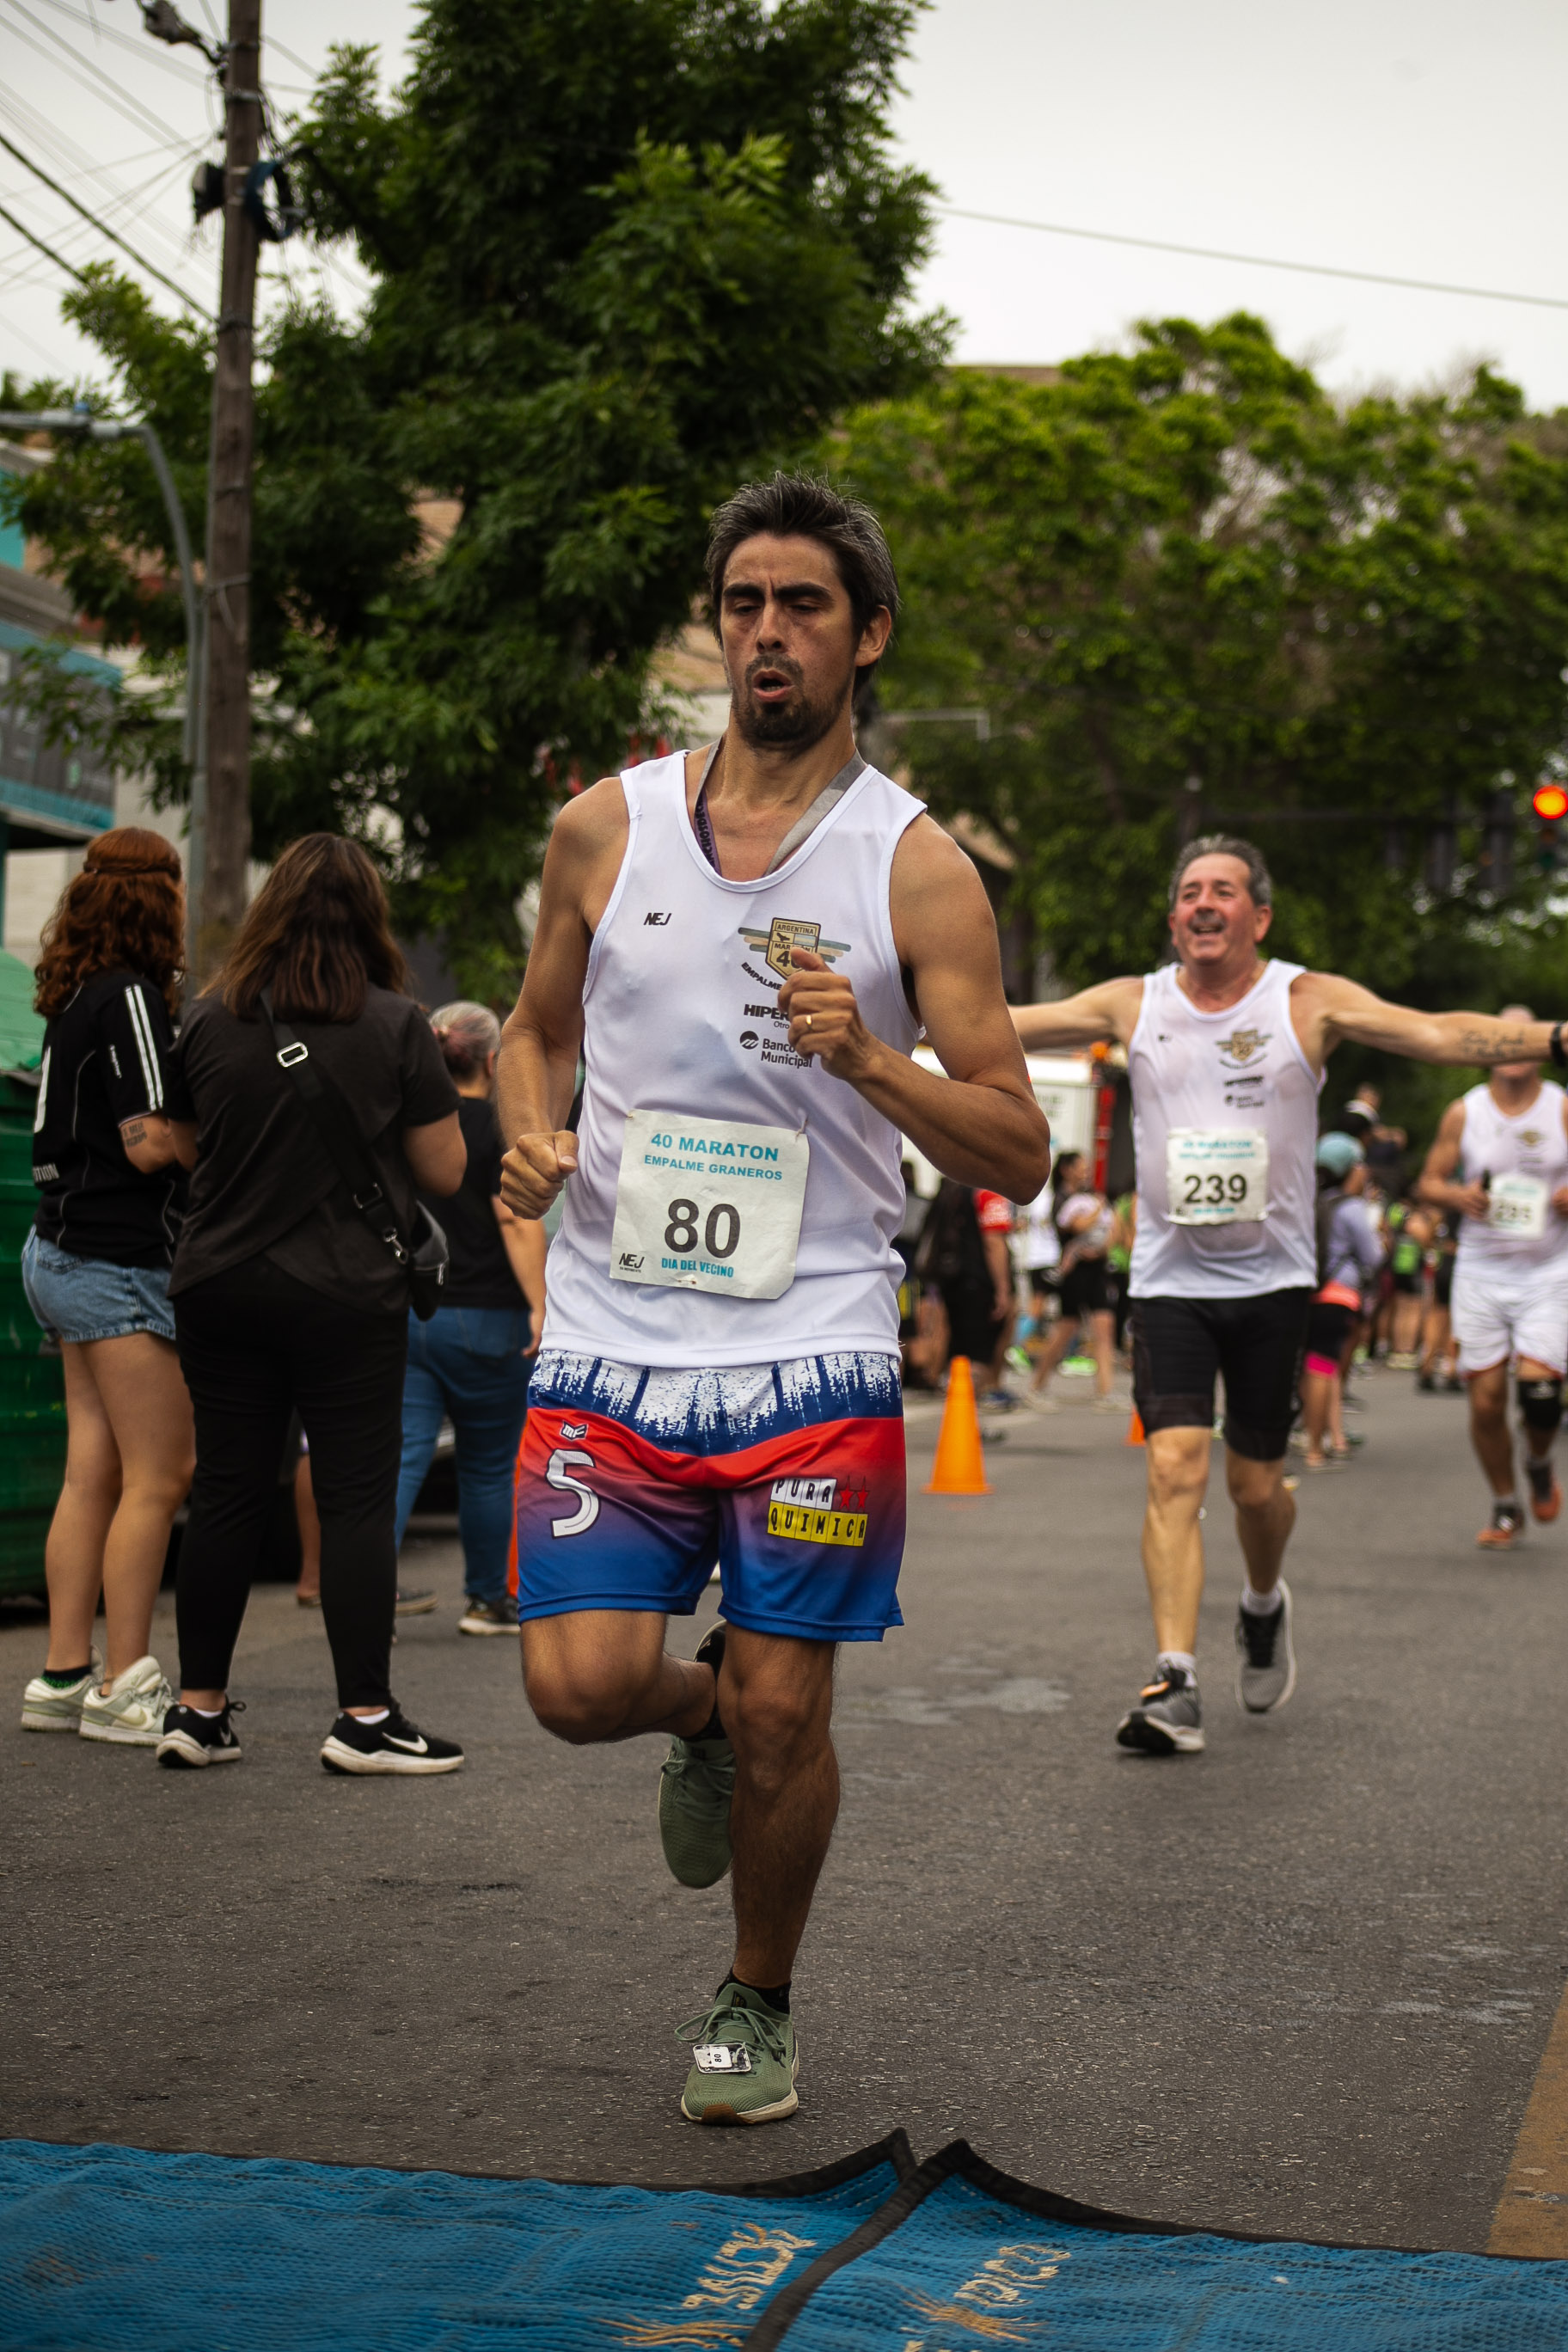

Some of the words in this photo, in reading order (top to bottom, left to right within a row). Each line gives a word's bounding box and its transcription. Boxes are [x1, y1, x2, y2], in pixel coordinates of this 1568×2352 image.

[644, 913, 672, 926] NEJ
[776, 924, 814, 934] ARGENTINA
[741, 962, 782, 990] EMPALME
[763, 1038, 795, 1053] Banco
[761, 1051, 812, 1069] Municipal
[651, 1133, 673, 1148] 40
[678, 1136, 779, 1161] MARATON
[644, 1155, 704, 1172] EMPALME
[709, 1164, 783, 1181] GRANEROS
[1184, 1173, 1247, 1204] 239
[665, 1198, 741, 1259] 80
[619, 1253, 645, 1269] NEJ
[661, 1258, 678, 1270] DIA
[681, 1260, 697, 1272] DEL
[699, 1262, 734, 1278] VECINO
[546, 1449, 600, 1539] 5
[775, 1478, 830, 1504] PURA
[769, 1507, 866, 1539] QUIMICA
